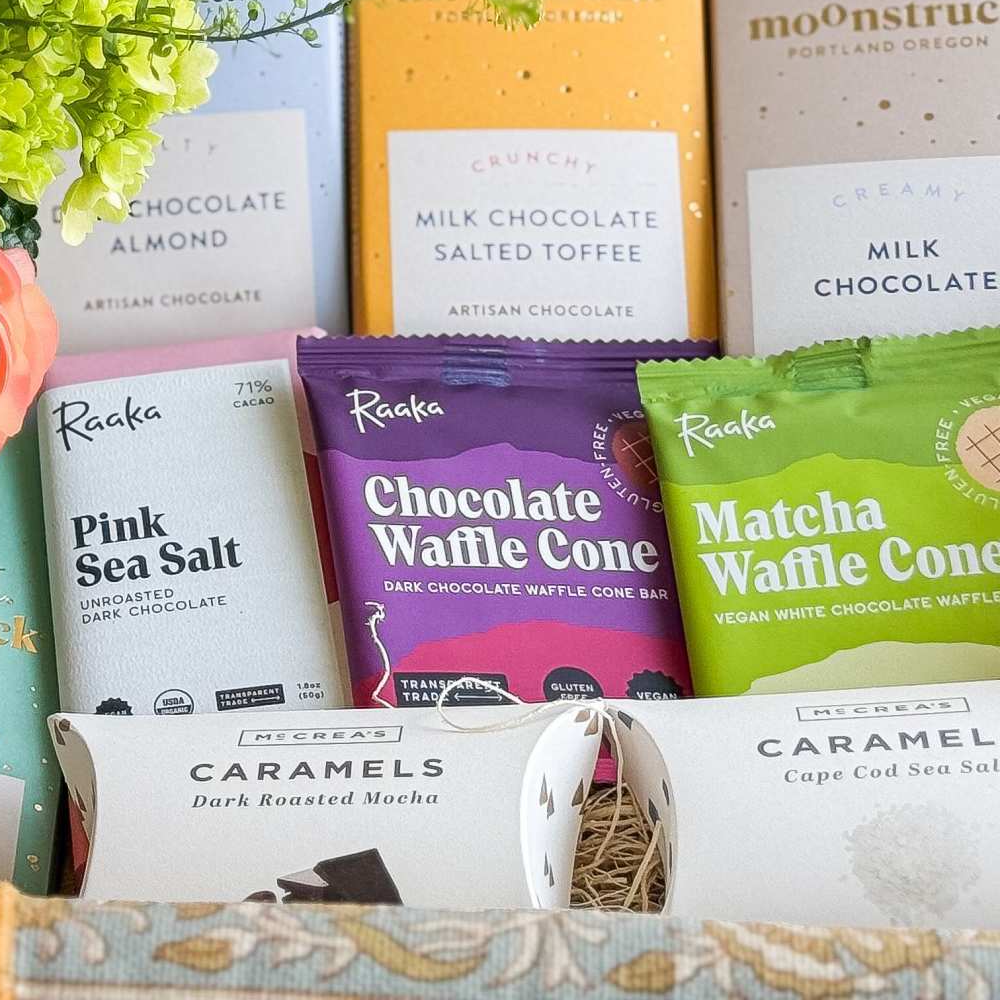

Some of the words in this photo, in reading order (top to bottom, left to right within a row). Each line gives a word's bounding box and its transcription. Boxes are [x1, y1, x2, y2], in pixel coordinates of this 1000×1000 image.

[749, 0, 1000, 41] moonstruc
[788, 40, 895, 59] PORTLAND
[903, 35, 989, 52] OREGON
[472, 151, 597, 174] CRUNCHY
[129, 192, 287, 218] CHOCOLATE
[833, 182, 966, 208] CREAMY
[416, 209, 478, 228] MILK
[489, 209, 659, 229] CHOCOLATE
[110, 230, 228, 255] ALMOND
[435, 243, 532, 262] SALTED
[543, 243, 642, 263] TOFFEE
[868, 239, 939, 260] MILK
[814, 271, 998, 297] CHOCOLATE
[84, 296, 153, 312] ARTISAN
[160, 289, 262, 307] CHOCOLATE
[448, 304, 521, 317] ARTISAN
[529, 304, 634, 318] CHOCOLATE
[234, 380, 272, 395] 71%
[233, 397, 275, 409] CACAO
[346, 389, 445, 433] Raaka
[960, 394, 1000, 408] VEG
[53, 397, 162, 451] Raaka
[674, 409, 776, 457] Raaka
[364, 475, 602, 523] Chocolate
[71, 506, 169, 550] Pink
[691, 491, 886, 544] Matcha
[368, 524, 528, 569] Waffle
[537, 528, 659, 573] Cone
[75, 553, 151, 587] Sea
[159, 536, 243, 576] Salt
[697, 544, 868, 597] Waffle
[878, 537, 1000, 583] Cone
[80, 588, 175, 611] UNROASTED
[384, 580, 423, 593] DARK
[428, 582, 521, 595] CHOCOLATE
[525, 584, 586, 597] WAFFLE
[591, 586, 635, 598] CONE
[640, 588, 668, 600] BAR
[81, 609, 122, 625] DARK
[129, 595, 228, 617] CHOCOLATE
[714, 612, 769, 625] VEGAN
[775, 606, 826, 620] WHITE
[832, 598, 932, 616] CHOCOLATE
[936, 591, 1000, 607] WAFFLE
[219, 688, 280, 700] TRANSPARENT
[551, 683, 594, 692] GLUTEN
[189, 758, 445, 782] CARAMELS
[784, 769, 844, 785] Cape
[853, 763, 898, 779] Cod
[908, 761, 951, 776] Sea
[191, 794, 250, 808] Dark
[258, 791, 355, 806] Roasted
[362, 790, 440, 805] Mocha
